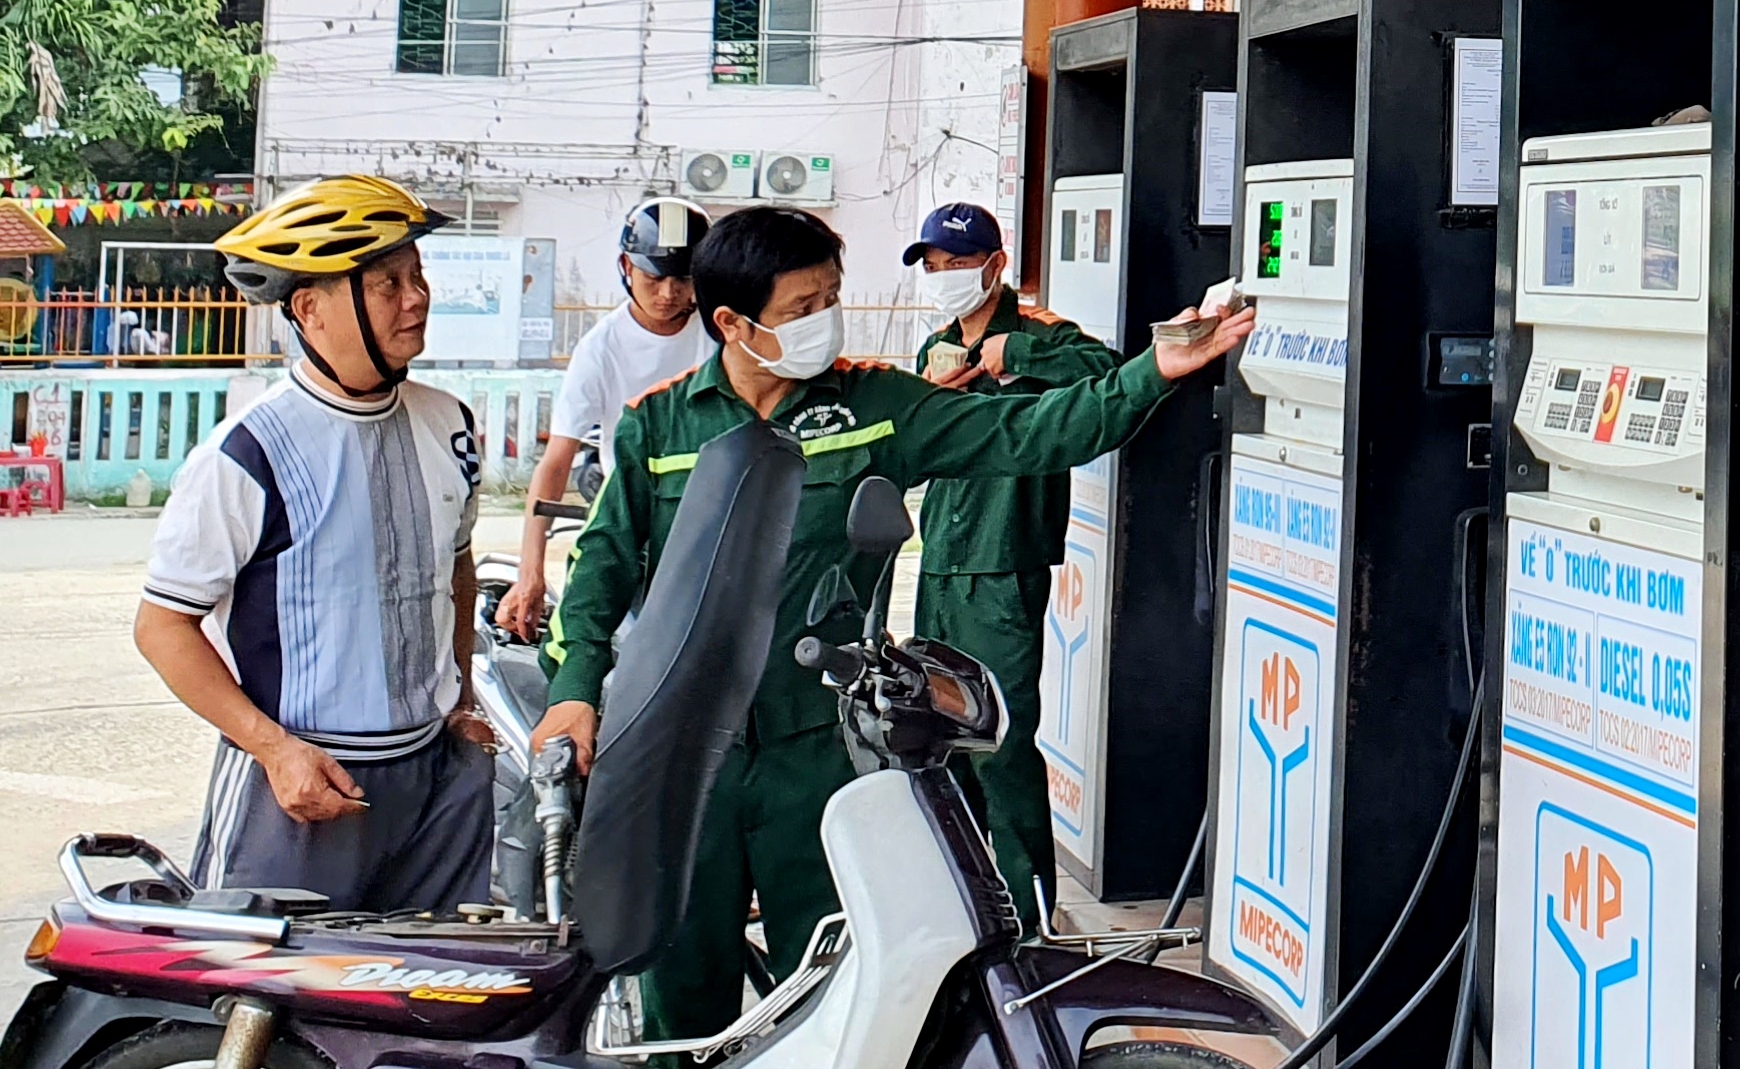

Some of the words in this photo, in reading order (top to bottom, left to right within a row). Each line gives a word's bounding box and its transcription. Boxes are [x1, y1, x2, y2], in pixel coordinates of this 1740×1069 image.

[1056, 559, 1084, 622] MP
[1564, 549, 1612, 598] TRƯỚC
[1616, 562, 1642, 606] KHI
[1647, 568, 1685, 617] BƠM
[1510, 600, 1533, 670] XĂNG
[1534, 616, 1545, 674] E5
[1547, 620, 1565, 681] RON
[1566, 626, 1577, 684] 92
[1599, 635, 1647, 708] DIESEL
[1651, 651, 1692, 723] 0,05S
[1261, 650, 1302, 732] MP
[1509, 677, 1528, 713] TCCS
[1598, 708, 1620, 747] TCCS
[1562, 845, 1623, 941] MP
[340, 962, 531, 990] Dream
[1239, 898, 1305, 981] MIPECORP
